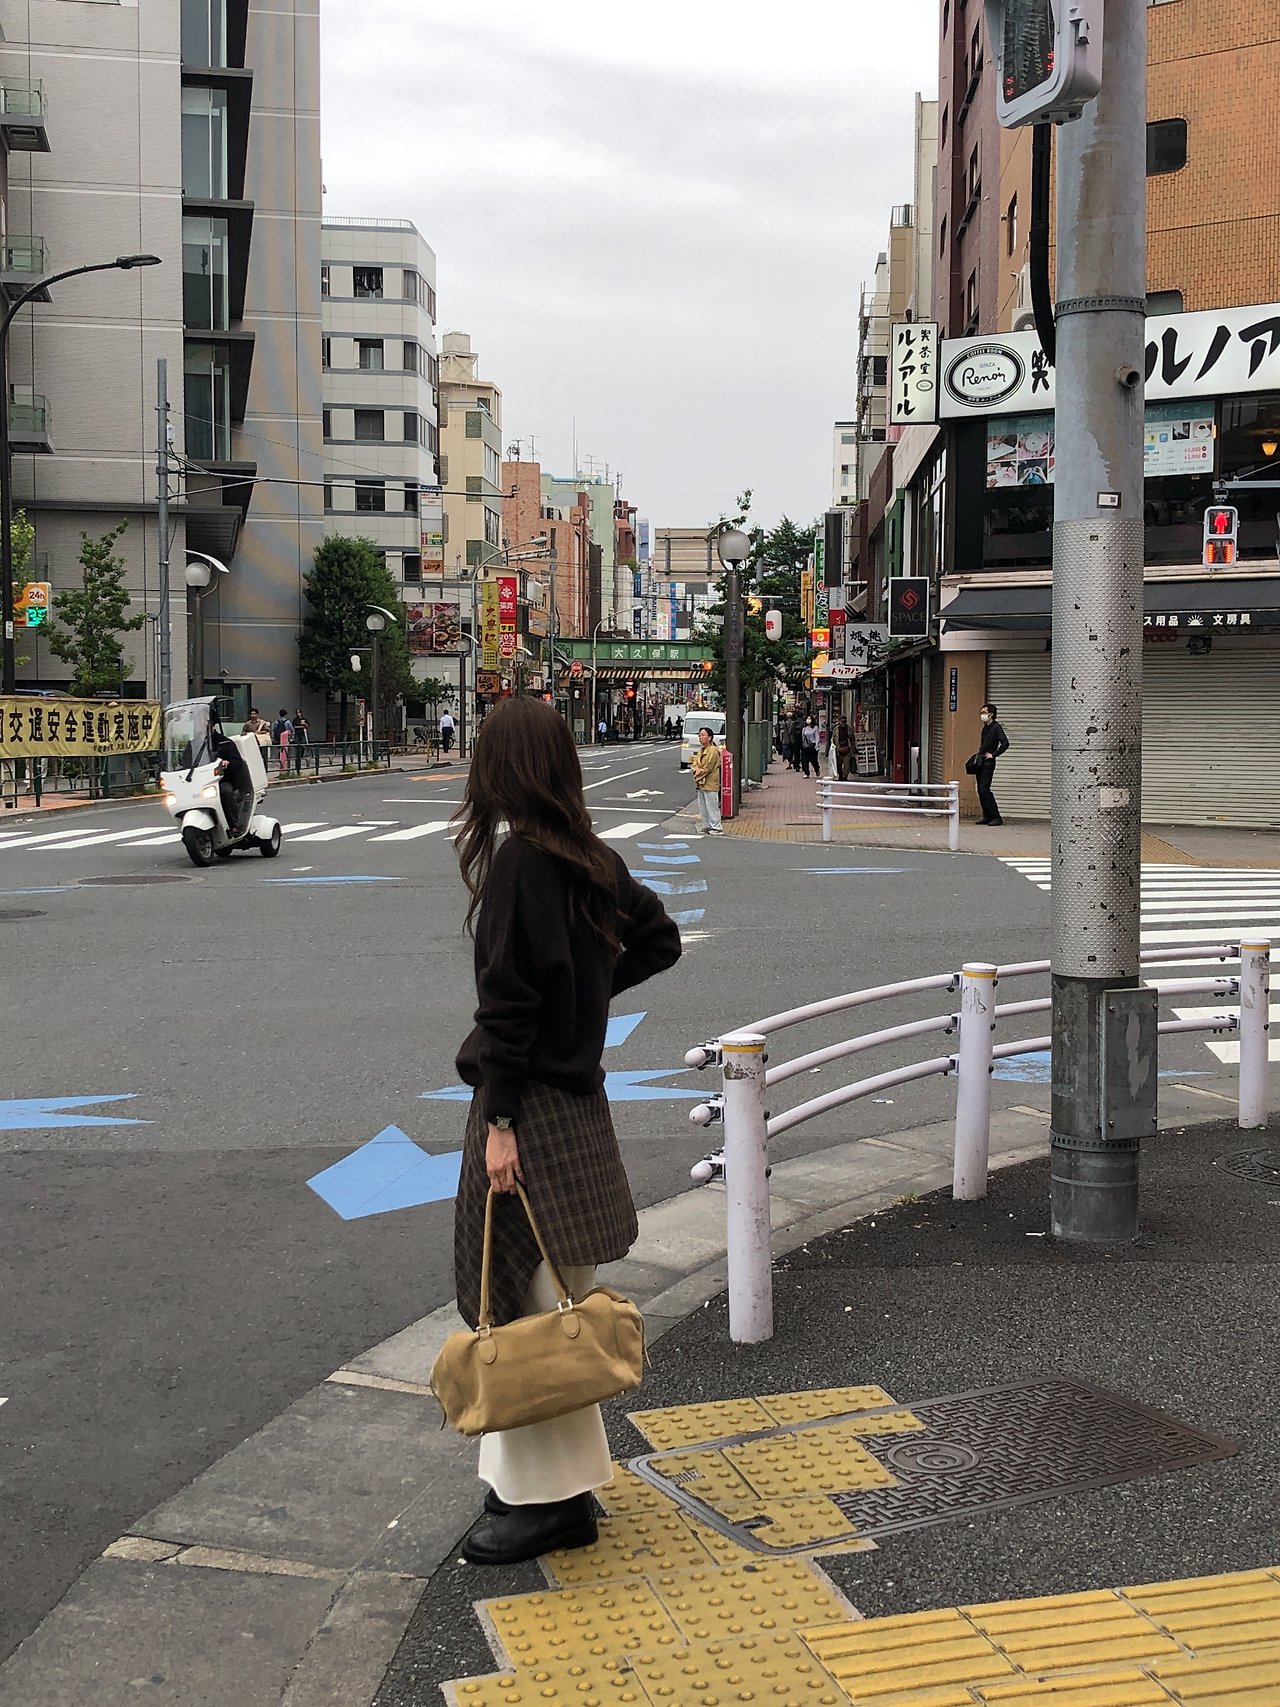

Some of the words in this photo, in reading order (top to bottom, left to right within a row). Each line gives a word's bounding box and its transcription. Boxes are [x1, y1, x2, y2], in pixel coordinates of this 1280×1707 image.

[919, 329, 932, 375] 喫茶室
[1145, 316, 1280, 386] ルノア
[897, 329, 918, 416] ルノアール
[979, 361, 996, 369] GINZA
[892, 611, 926, 622] SPACE
[1213, 614, 1251, 625] 文房具
[614, 649, 680, 659] 大久保駅
[0, 706, 153, 743] 交通安全運動実施中
